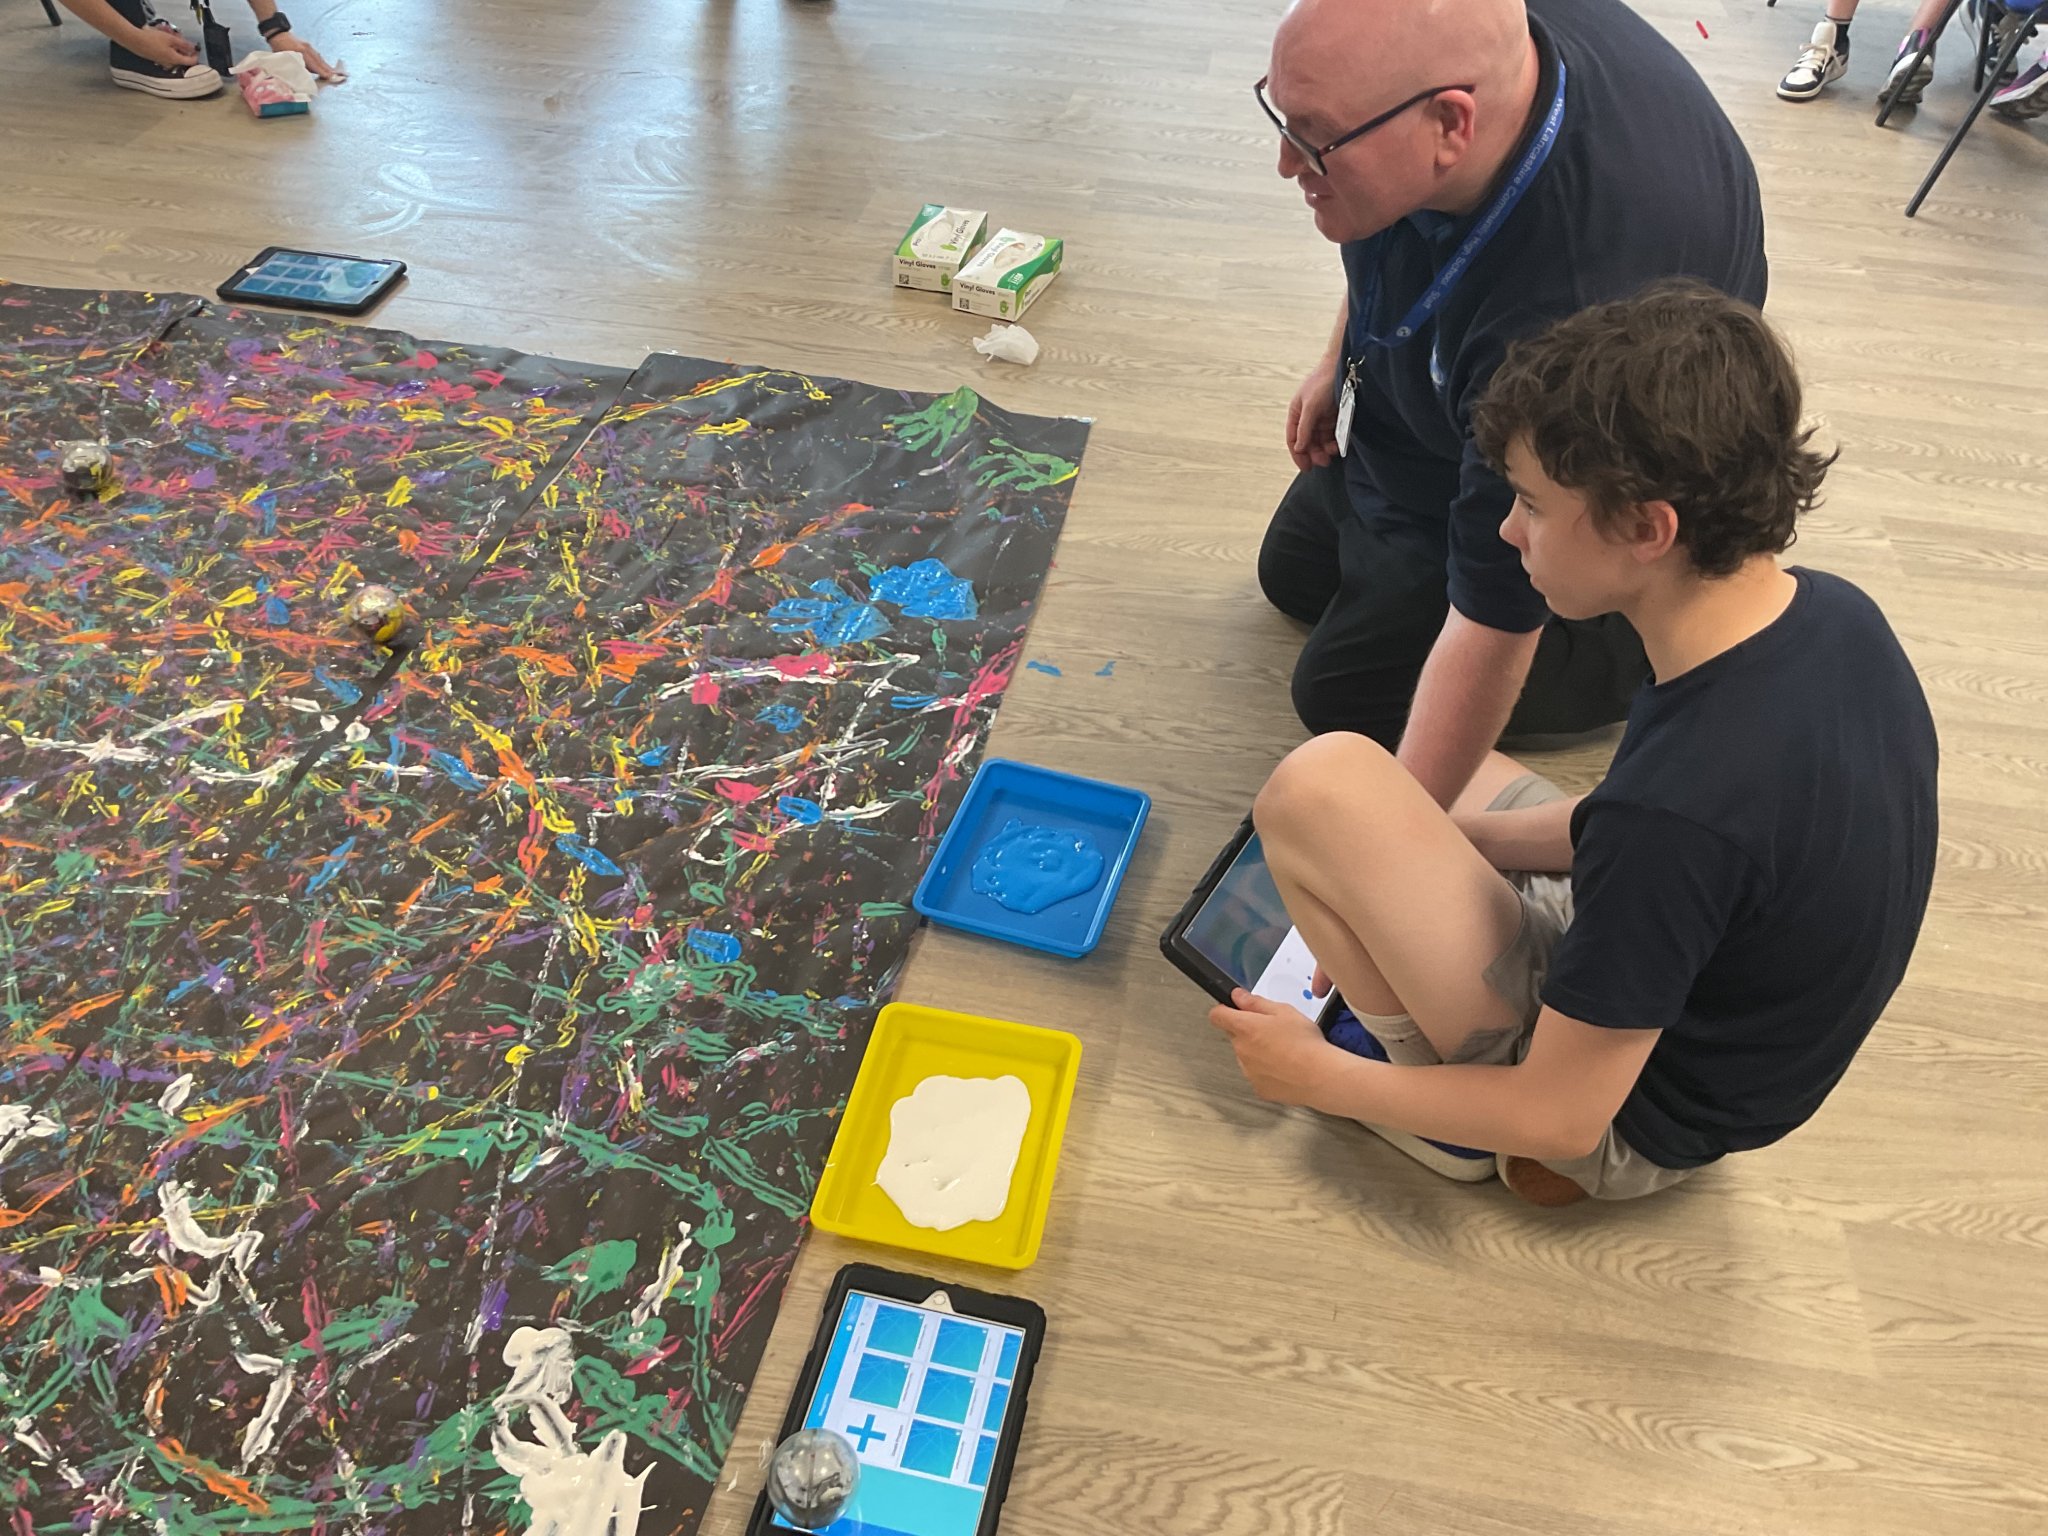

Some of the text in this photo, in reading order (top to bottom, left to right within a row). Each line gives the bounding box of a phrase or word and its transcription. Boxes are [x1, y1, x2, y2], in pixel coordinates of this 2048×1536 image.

[1550, 98, 1563, 127] West
[1513, 127, 1554, 185] Lancashire
[899, 259, 915, 267] Vinyl
[916, 261, 936, 269] Gloves
[1441, 256, 1466, 286] School
[960, 282, 975, 292] Vinyl
[975, 286, 996, 296] Gloves
